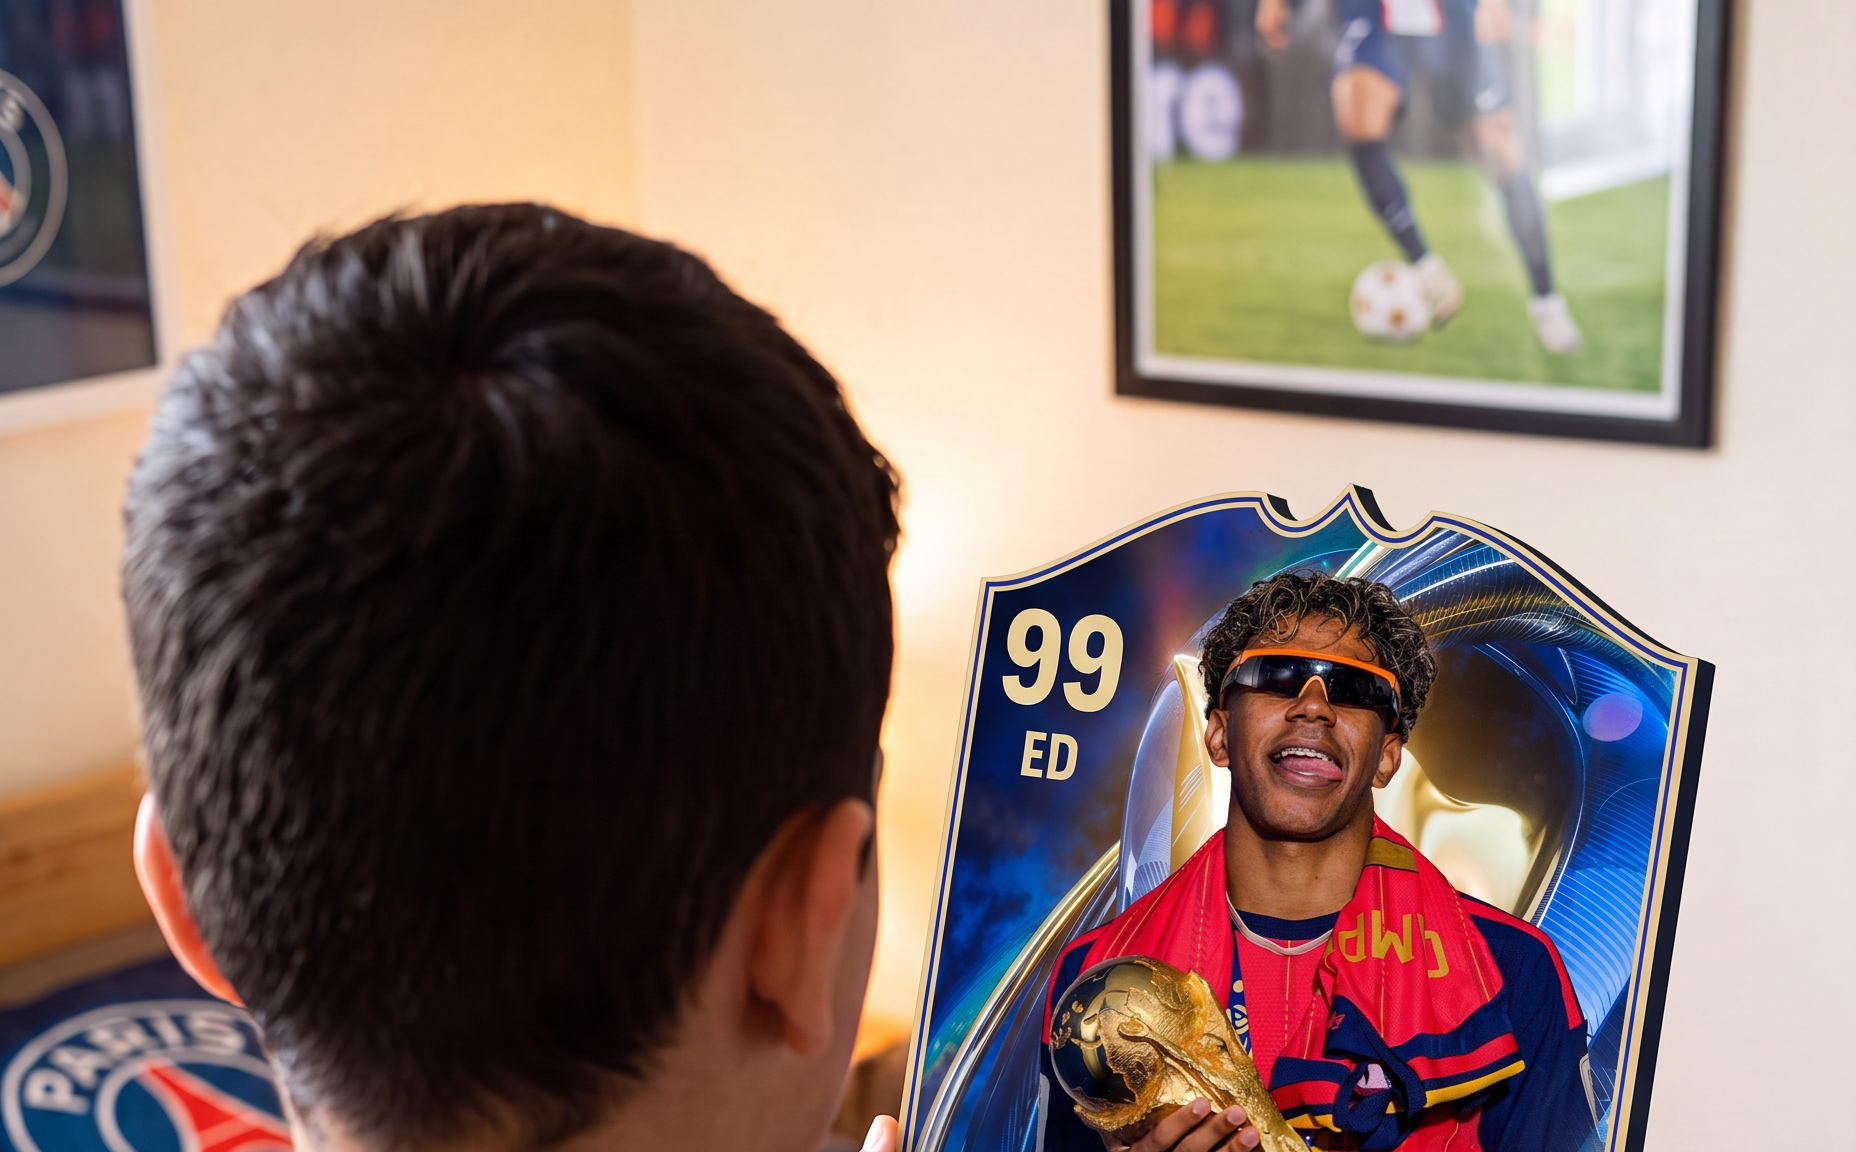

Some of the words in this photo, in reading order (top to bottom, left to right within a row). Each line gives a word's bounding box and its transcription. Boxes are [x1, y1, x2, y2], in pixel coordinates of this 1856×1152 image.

[1002, 608, 1124, 713] 99
[1021, 730, 1078, 781] ED
[24, 1010, 246, 1115] PARIS
